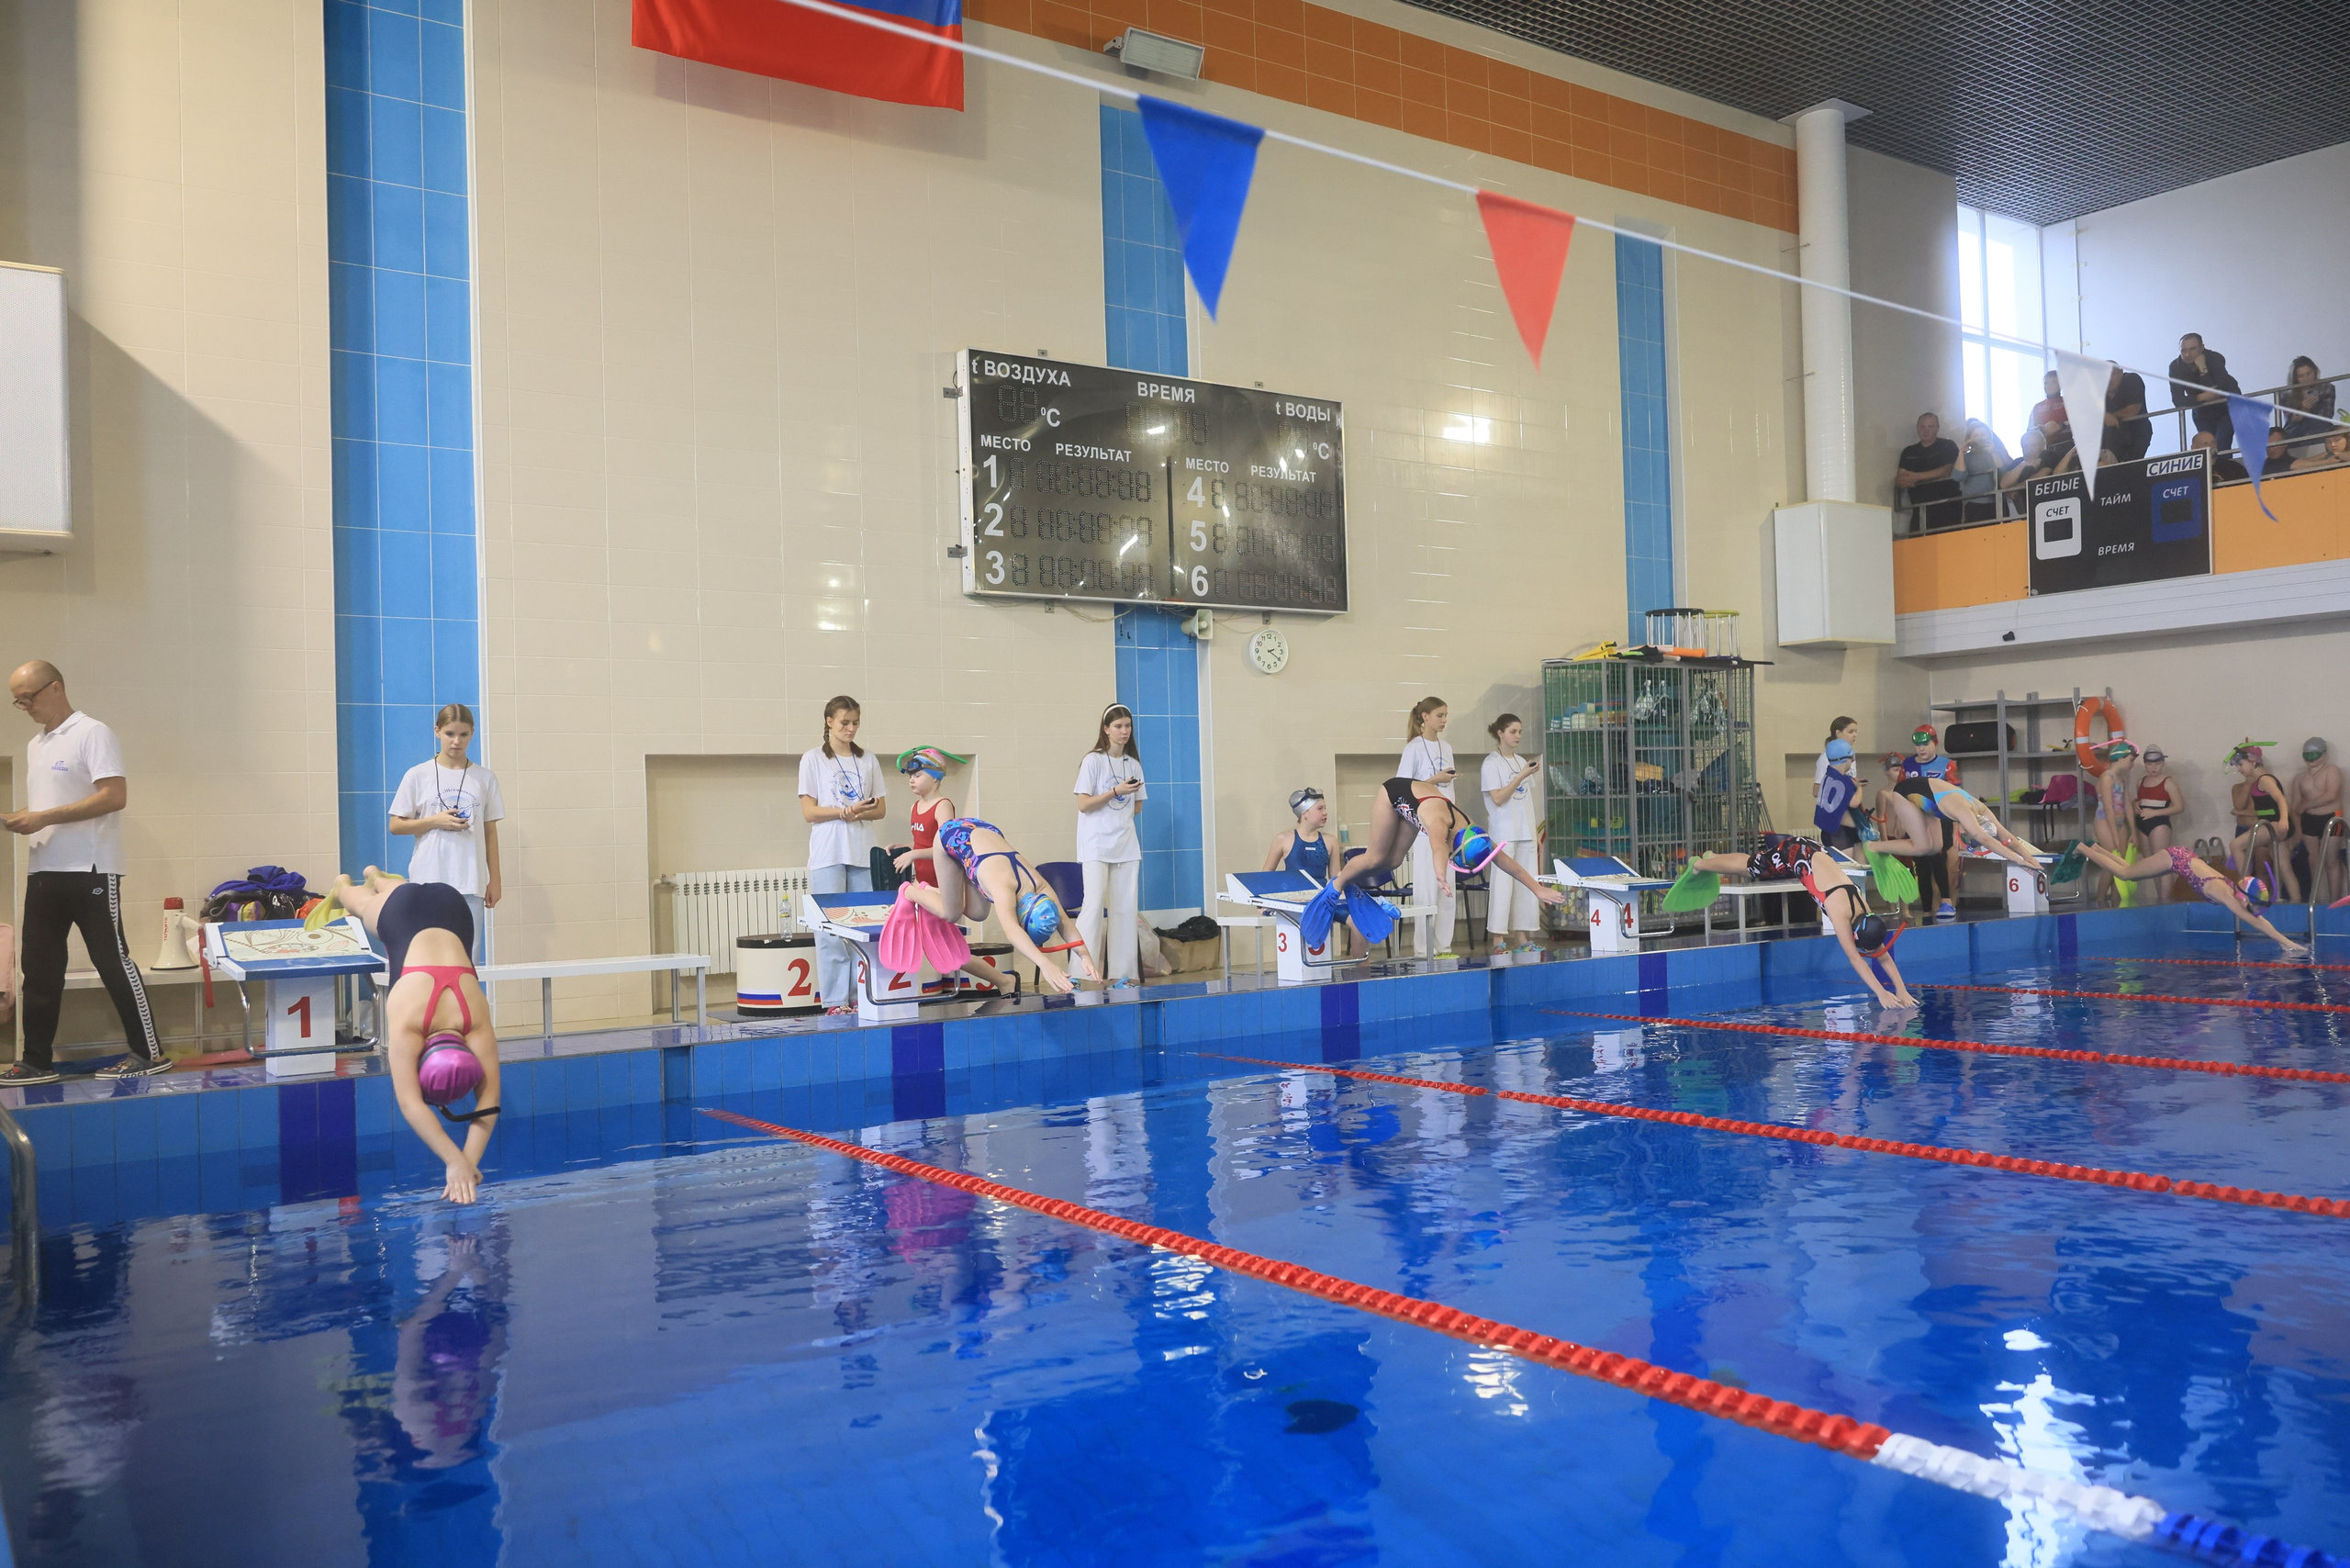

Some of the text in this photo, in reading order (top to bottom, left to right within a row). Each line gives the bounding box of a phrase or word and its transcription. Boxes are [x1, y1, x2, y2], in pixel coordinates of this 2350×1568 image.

[984, 359, 1071, 386] ВОЗДУХА
[1137, 381, 1195, 403] ВРЕМЯ
[1285, 402, 1330, 422] ВОДЫ
[980, 434, 1032, 452] МЕСТО
[1055, 442, 1132, 463] РЕЗУЛЬТАТ
[983, 454, 998, 488] 1
[1185, 457, 1229, 474] МЕСТО
[1250, 465, 1317, 483] РЕЗУЛЬТАТ
[2148, 455, 2202, 476] СИНИЕ
[1187, 476, 1206, 508] 4
[2034, 476, 2080, 497] БЕЛЫЕ
[2162, 486, 2189, 498] СЧЕТ
[2100, 493, 2132, 507] ТАЙМ
[984, 502, 1004, 537] 2
[2046, 505, 2070, 518] СЧЕТ
[1190, 520, 1207, 552] 5
[2098, 542, 2135, 556] ВРЕМЯ
[985, 550, 1005, 585] 3
[1191, 565, 1209, 597] 6
[2009, 878, 2019, 892] 6
[2037, 872, 2045, 894] 6
[1590, 909, 1601, 926] 4
[1278, 932, 1288, 953] 3
[787, 958, 812, 997] 2
[857, 960, 866, 984] 2
[287, 995, 311, 1038] 1
